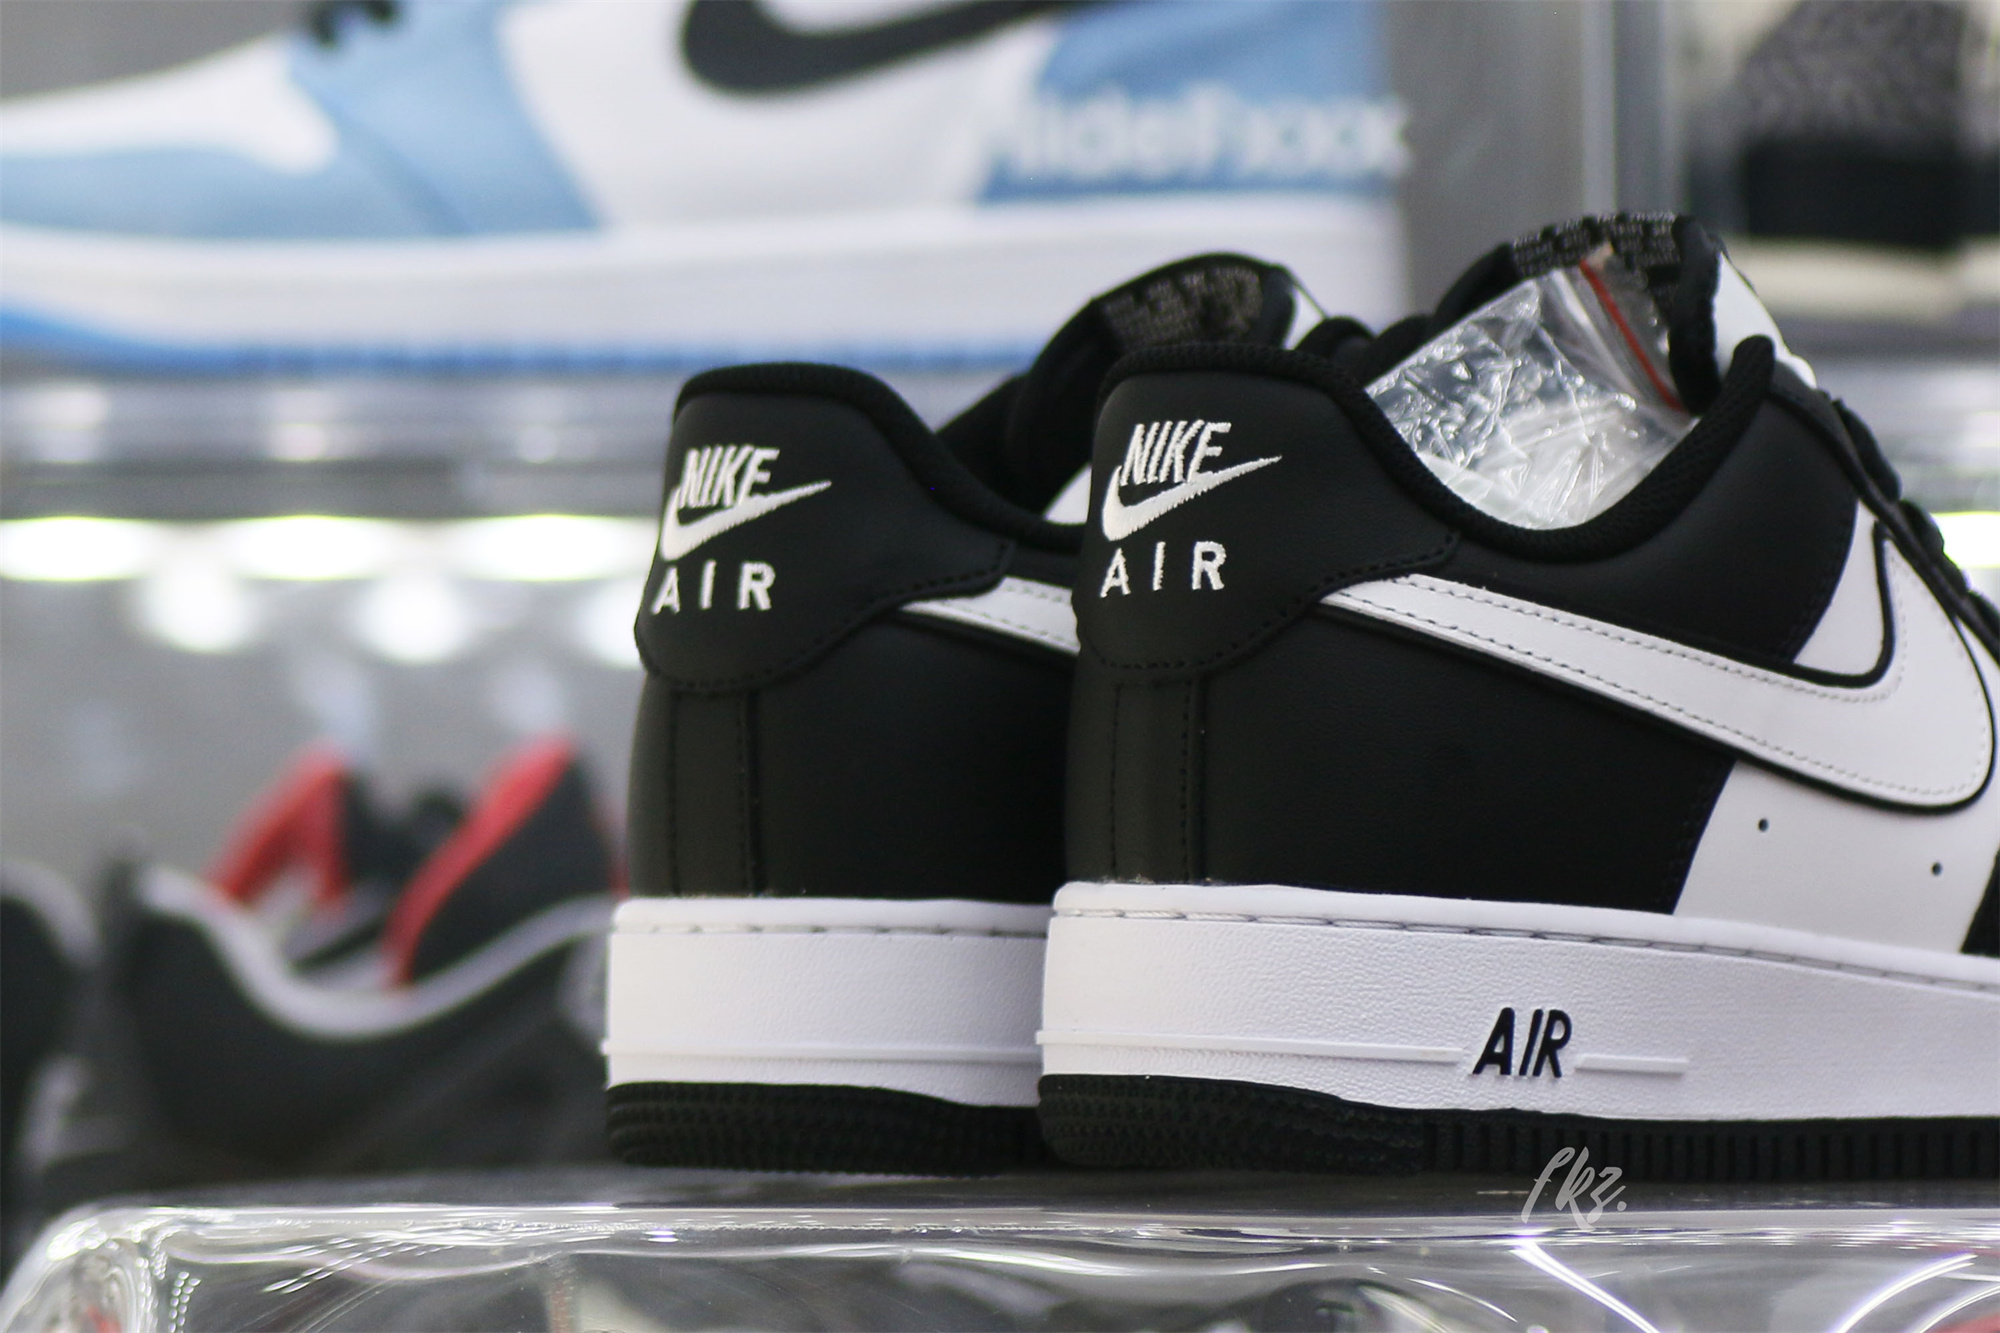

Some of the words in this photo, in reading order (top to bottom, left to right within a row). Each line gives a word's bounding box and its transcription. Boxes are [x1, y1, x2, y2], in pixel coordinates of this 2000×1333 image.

[679, 444, 781, 508] NIKE
[1119, 419, 1232, 487] NIKE
[652, 559, 776, 615] AIR
[1100, 541, 1227, 598] AIR
[1472, 1006, 1572, 1078] AIR
